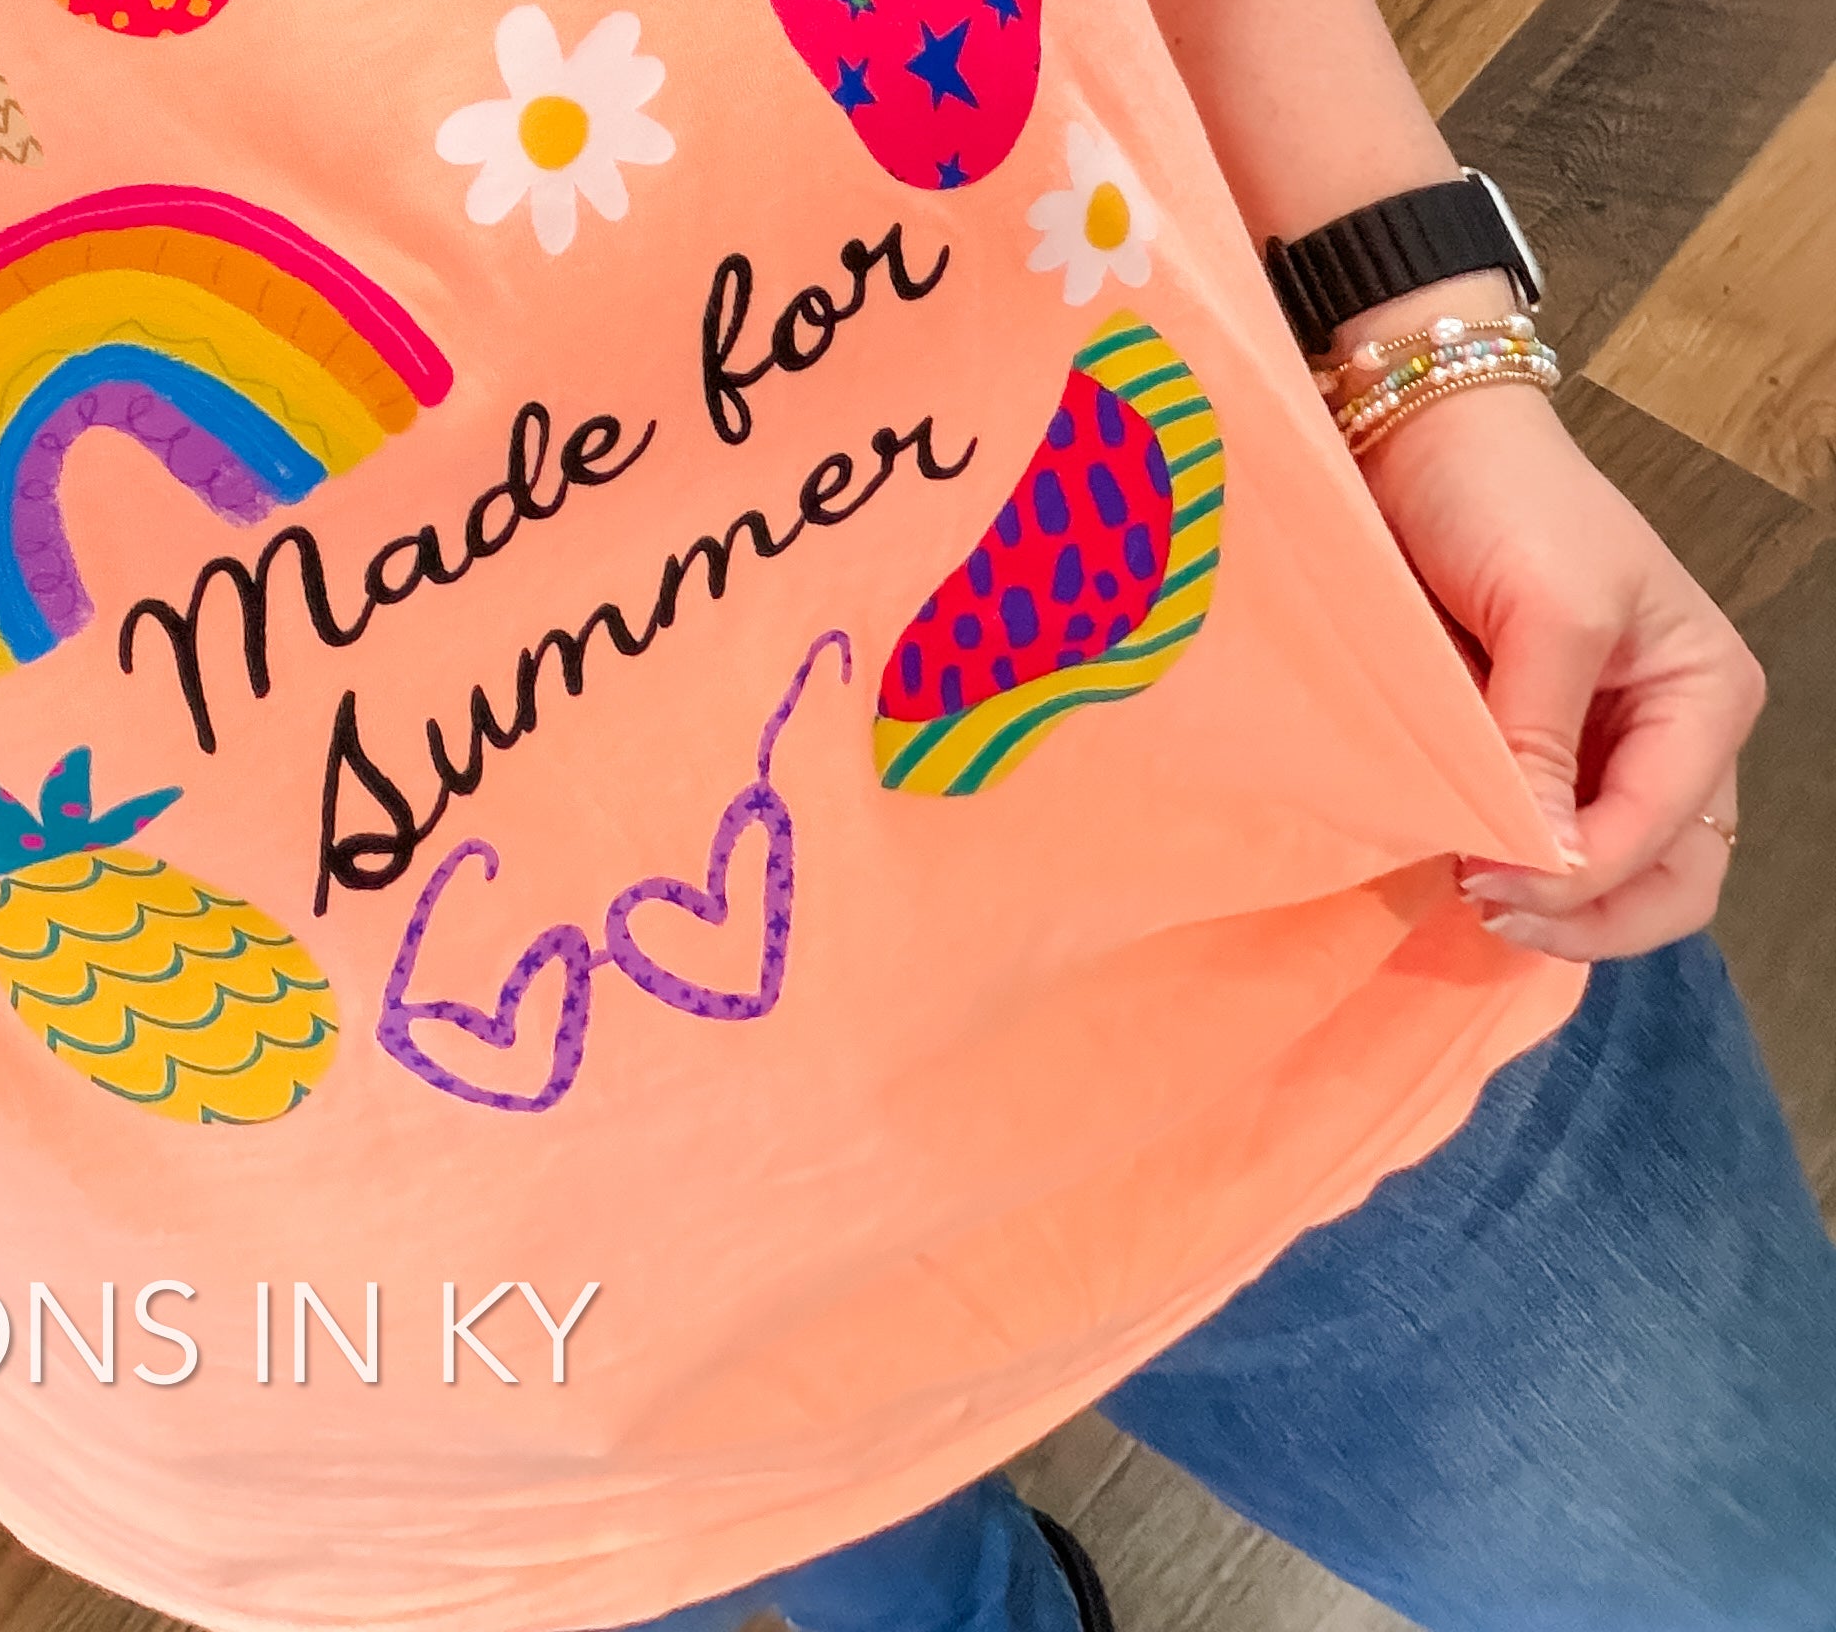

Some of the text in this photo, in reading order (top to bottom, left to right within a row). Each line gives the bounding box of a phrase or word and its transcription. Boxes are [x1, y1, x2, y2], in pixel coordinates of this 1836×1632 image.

[119, 222, 951, 755] Made for
[313, 413, 977, 917] Summer
